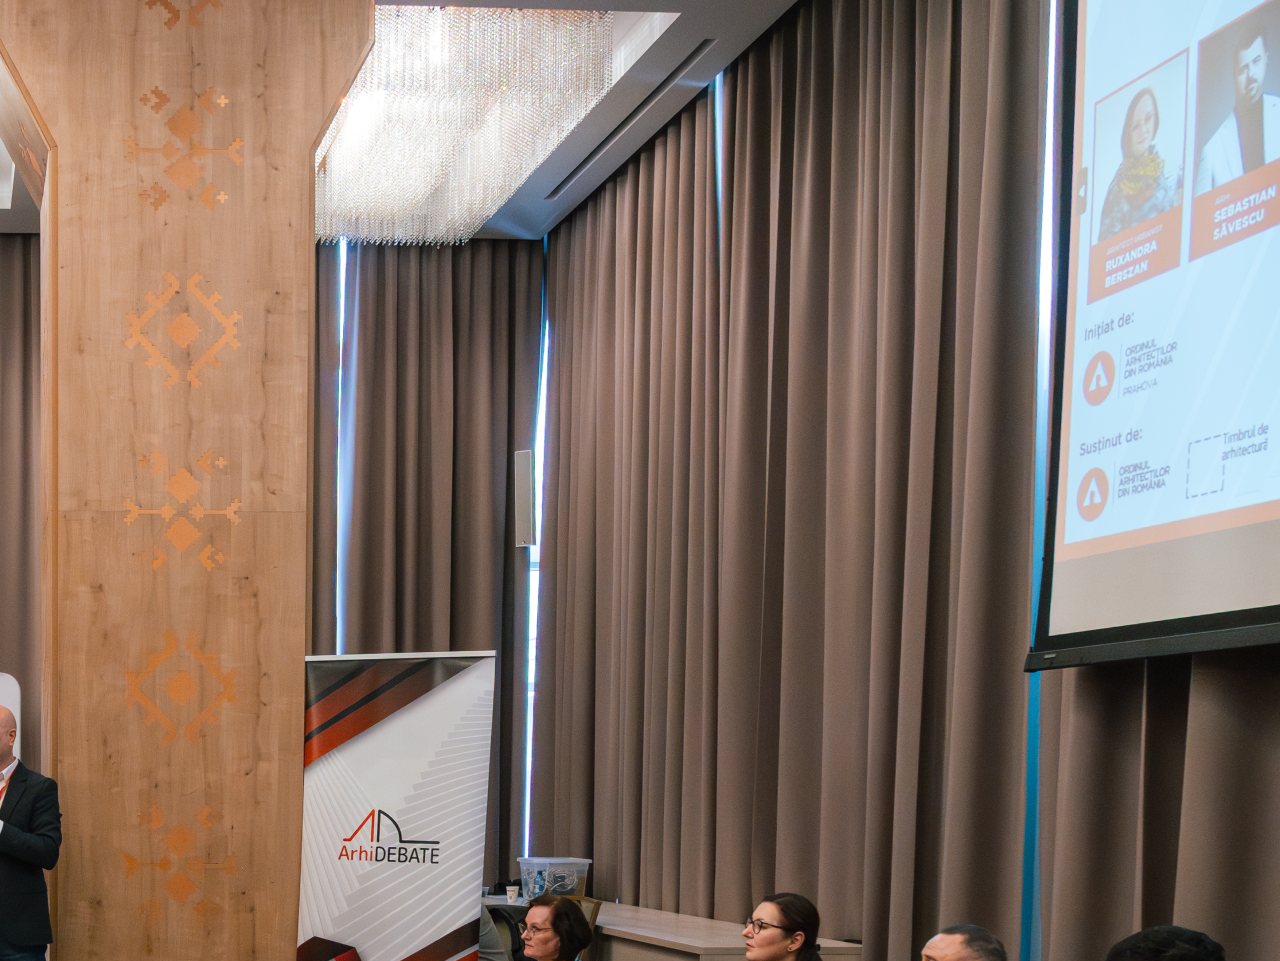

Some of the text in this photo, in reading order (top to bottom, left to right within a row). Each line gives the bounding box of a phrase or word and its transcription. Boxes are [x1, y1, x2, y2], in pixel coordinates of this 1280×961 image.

[1215, 185, 1276, 222] SEBASTIAN
[1213, 208, 1265, 240] SĂVESCU
[1105, 240, 1157, 272] RUXANDRA
[1104, 260, 1148, 288] BERSZAN
[1117, 312, 1135, 329] de:
[1125, 338, 1157, 357] ORDINUL
[1123, 366, 1137, 379] DIN
[1125, 427, 1143, 444] de:
[1223, 422, 1269, 444] Timbrul de
[1119, 460, 1151, 476] ORDINUL
[1118, 487, 1130, 499] DIN
[337, 845, 440, 865] ArhiDEBATE
